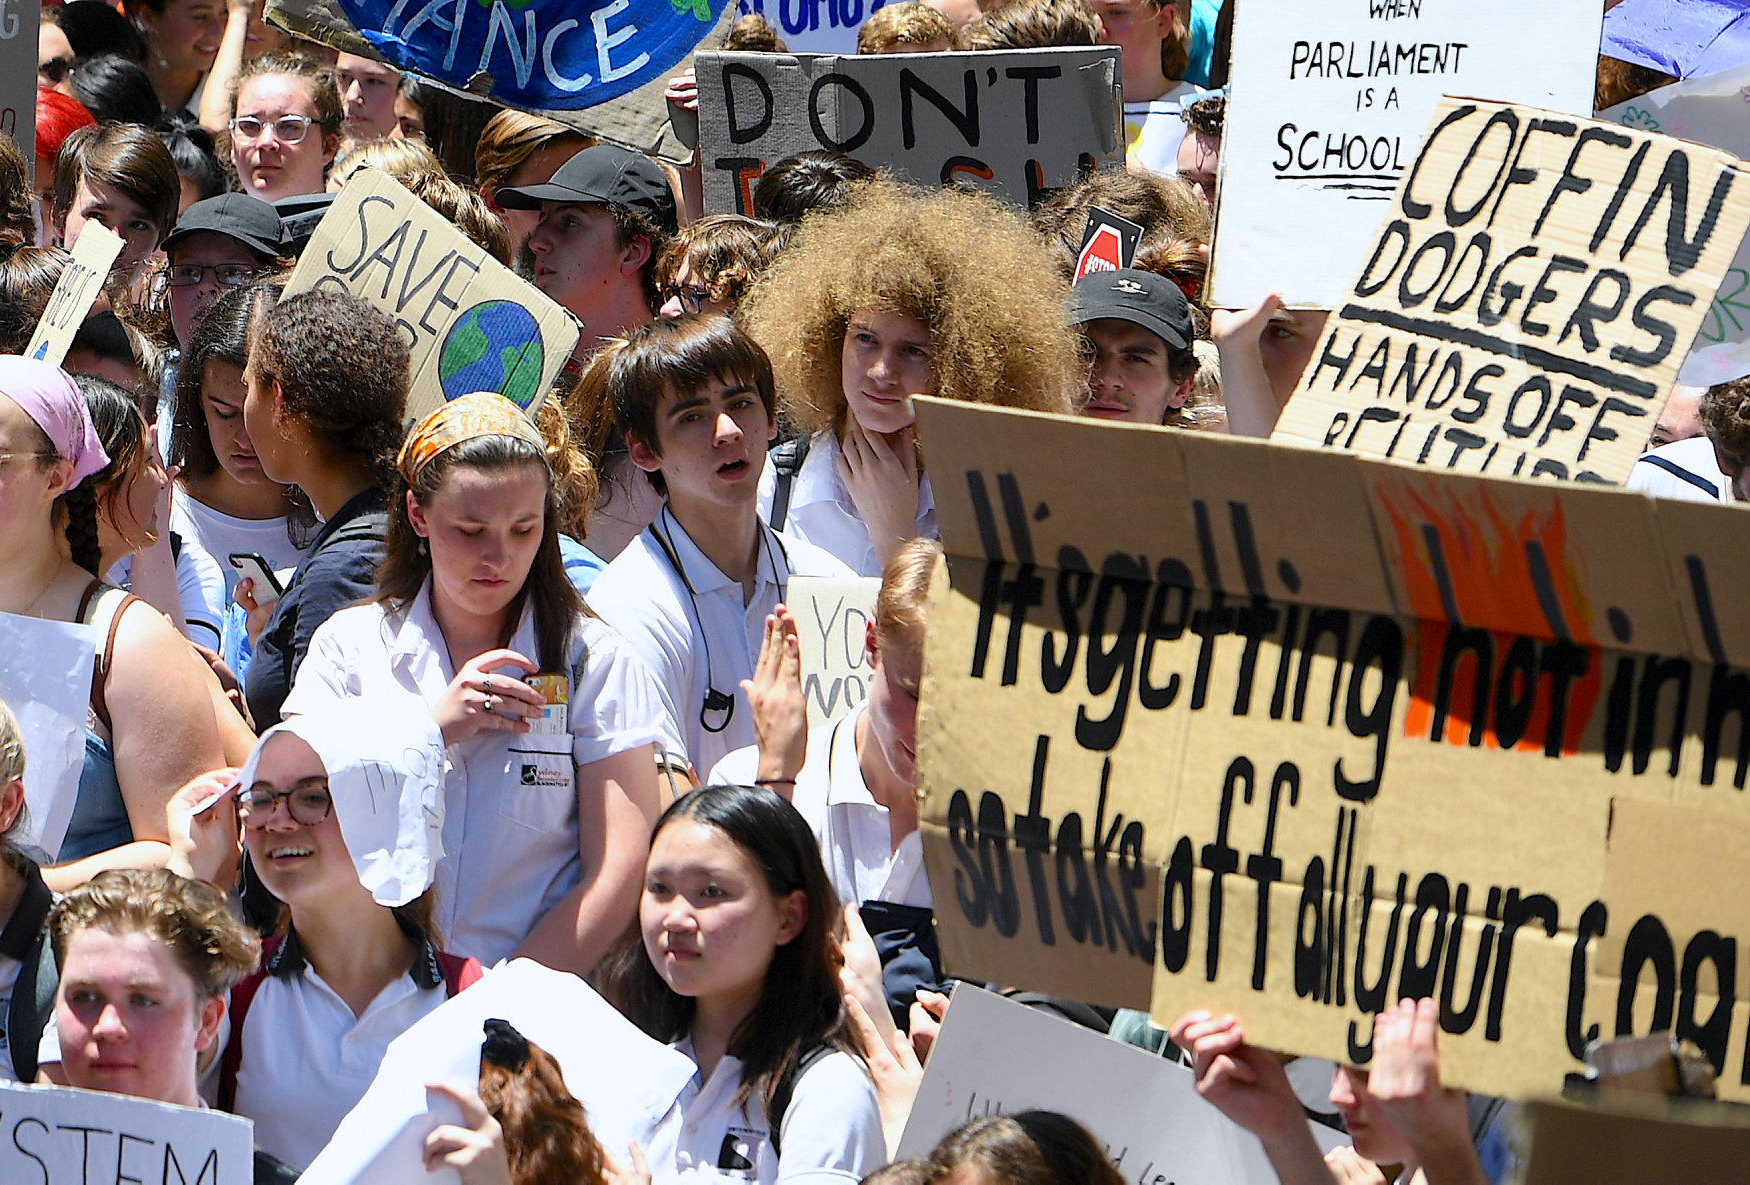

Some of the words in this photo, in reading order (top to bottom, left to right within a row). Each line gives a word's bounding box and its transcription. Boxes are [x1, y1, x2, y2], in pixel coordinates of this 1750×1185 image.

[720, 63, 1063, 153] DON'T
[1289, 40, 1469, 80] PARLIAMENT
[1356, 86, 1374, 113] IS
[1384, 87, 1400, 110] A
[1272, 122, 1406, 173] SCHOOL
[1401, 105, 1739, 278] COFFIN
[325, 194, 481, 336] SAVE
[1353, 219, 1697, 369] DODGERS
[1307, 326, 1506, 424] HANDS
[1502, 373, 1649, 464] OFF
[1075, 499, 1408, 804] getting
[1421, 523, 1593, 760] hot
[1602, 607, 1692, 777] in
[949, 786, 1019, 940] so
[1014, 735, 1156, 966] take
[1163, 755, 1300, 992] off
[1294, 806, 1358, 1007] all
[1348, 862, 1560, 1064] your
